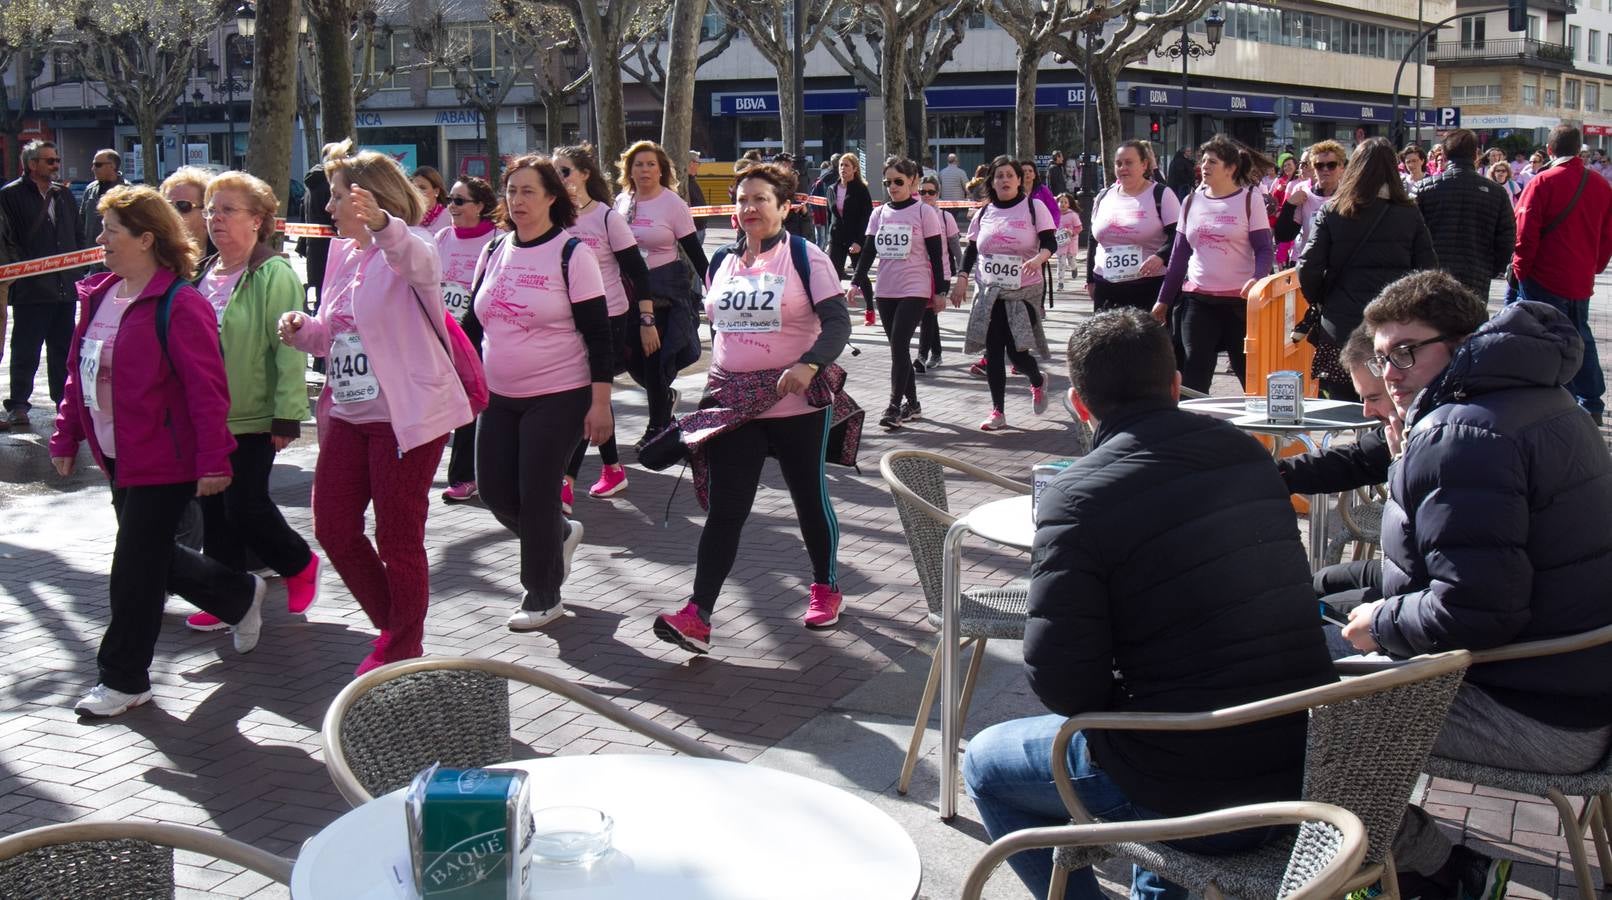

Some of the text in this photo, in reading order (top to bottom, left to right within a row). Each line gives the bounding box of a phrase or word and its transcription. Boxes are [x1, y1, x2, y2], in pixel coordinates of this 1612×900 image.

[736, 98, 766, 110] BBVA
[1149, 90, 1168, 103] BBVA
[1231, 97, 1247, 109] BBVA
[1441, 108, 1455, 125] P
[877, 233, 909, 246] 6619
[1106, 253, 1139, 269] 6365
[984, 262, 1019, 277] 6046
[719, 290, 775, 311] 3012
[430, 833, 503, 885] BAQUÉ
